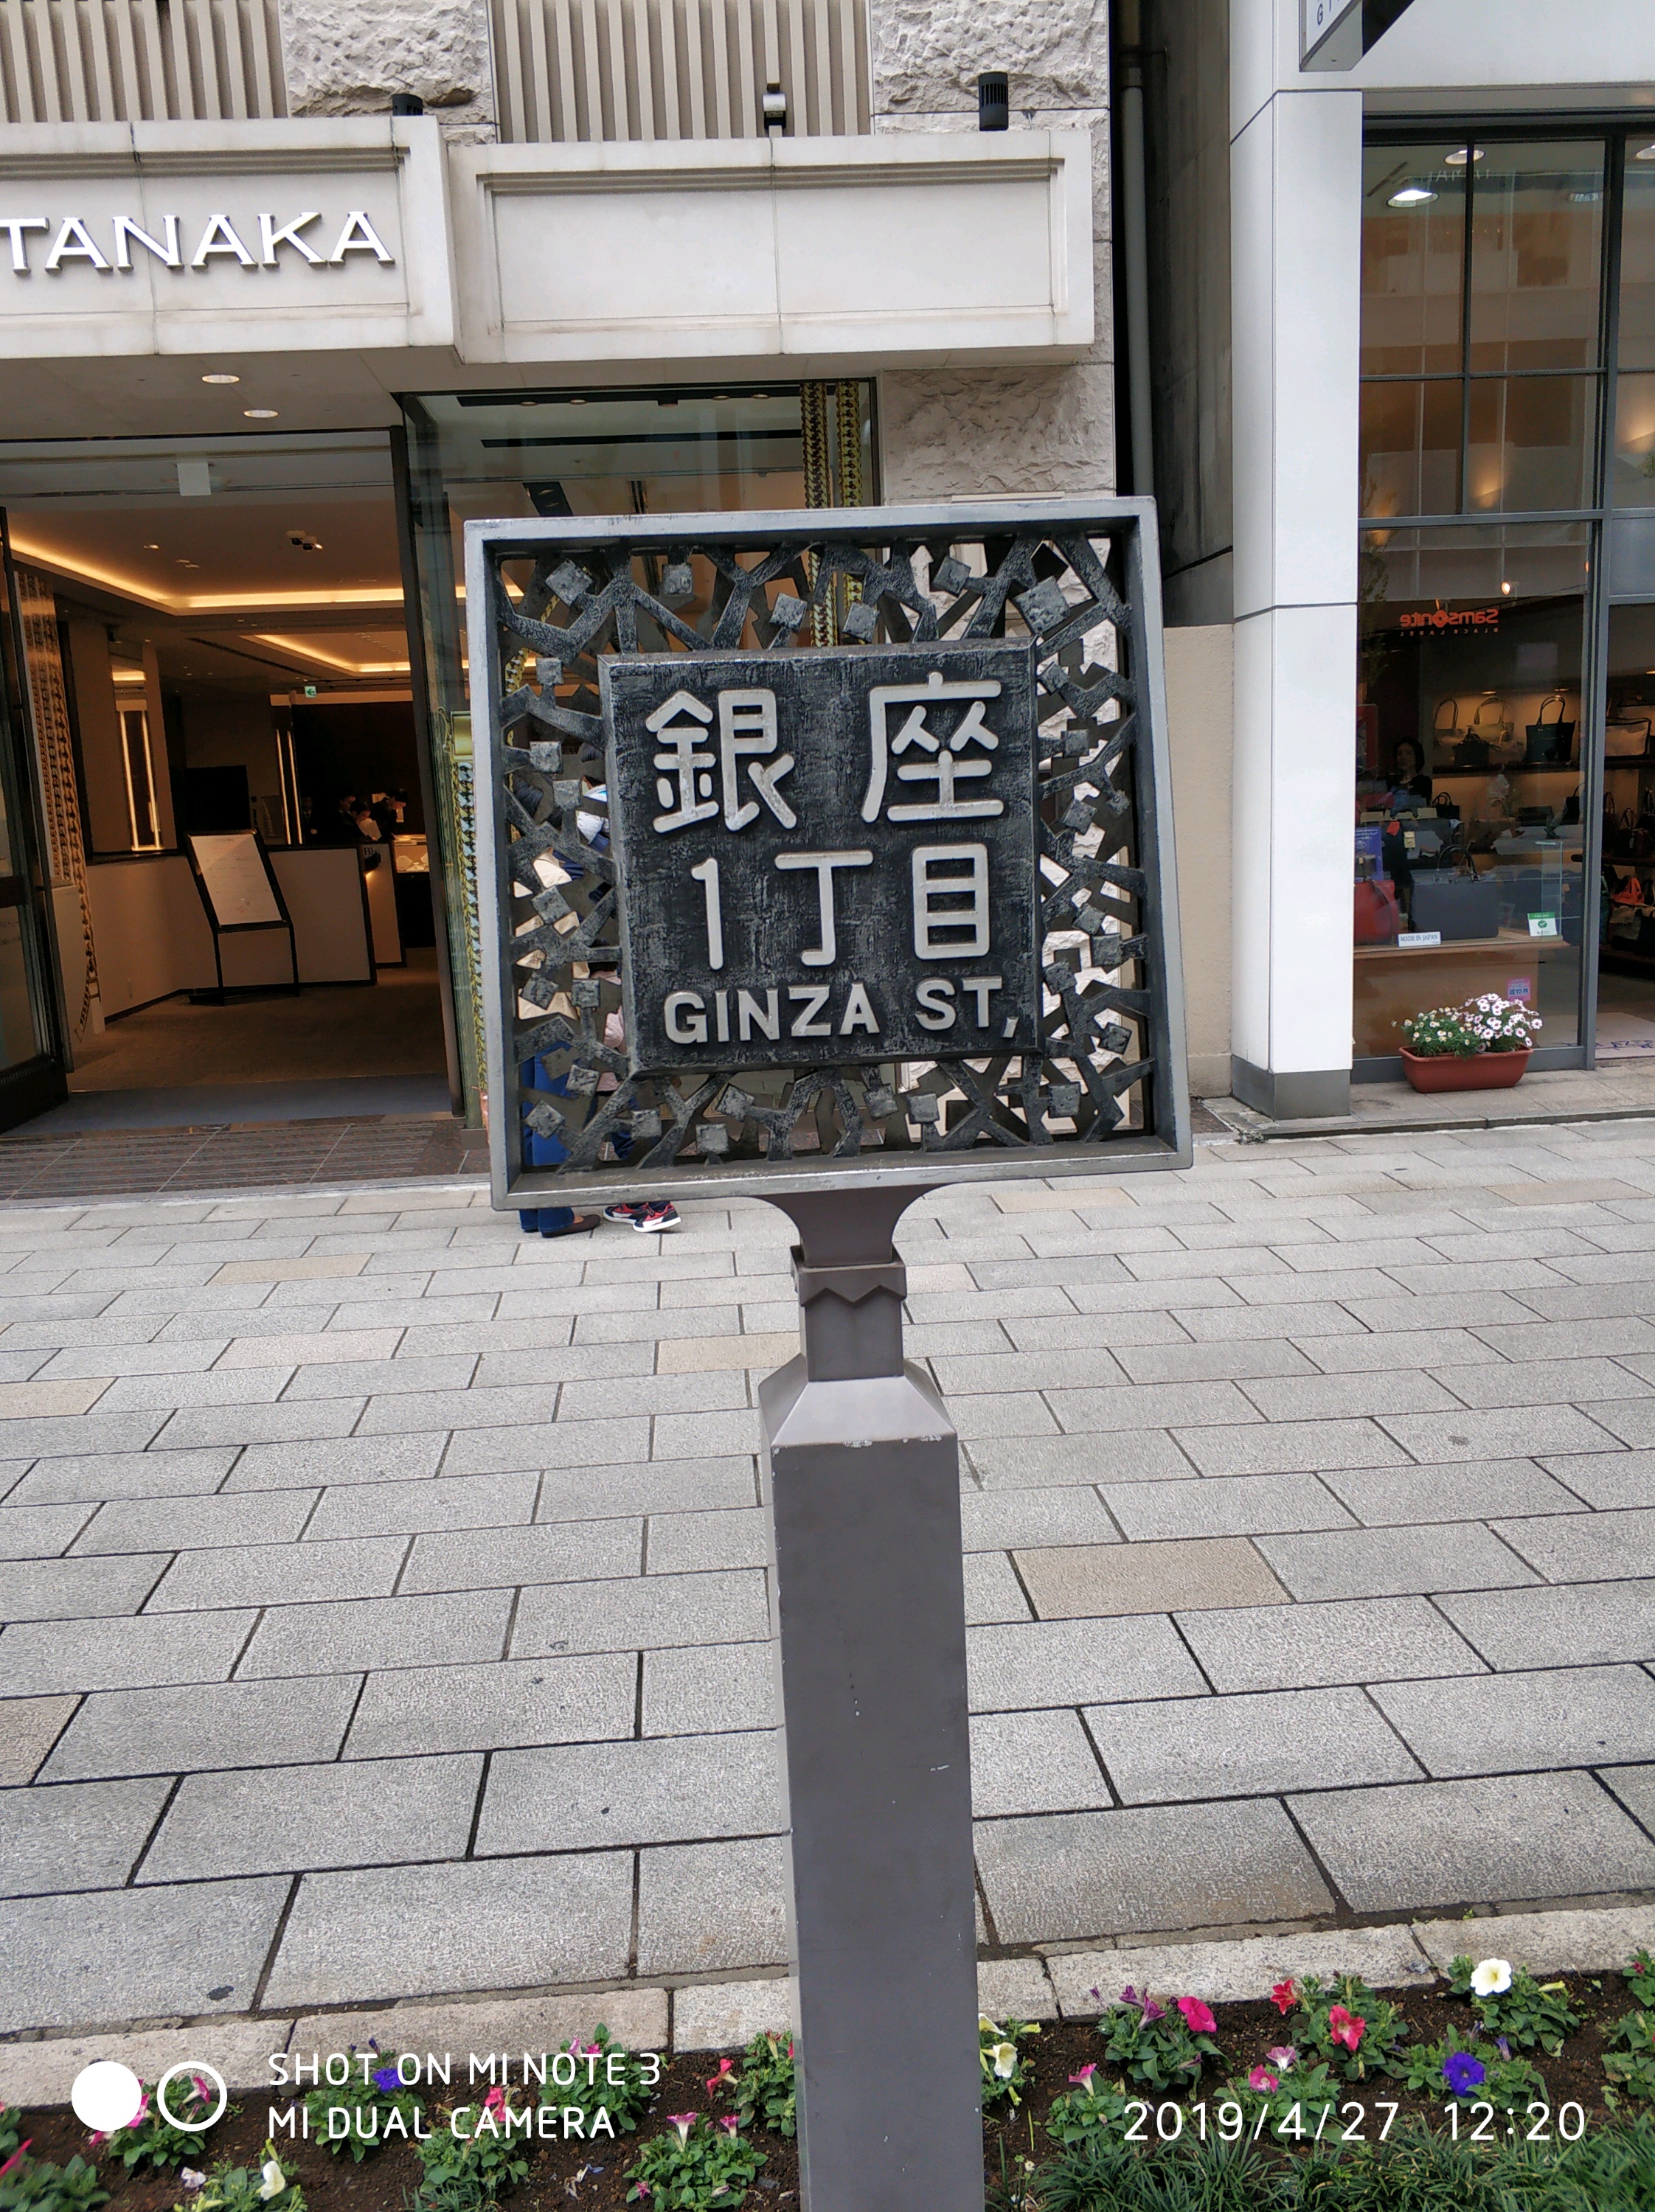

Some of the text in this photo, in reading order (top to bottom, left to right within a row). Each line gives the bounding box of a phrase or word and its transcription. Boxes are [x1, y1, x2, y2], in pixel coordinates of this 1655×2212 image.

[0, 211, 395, 273] TANAKA
[646, 672, 1003, 831] 銀座
[690, 843, 988, 970] 1丁目
[663, 983, 879, 1046] GINZA
